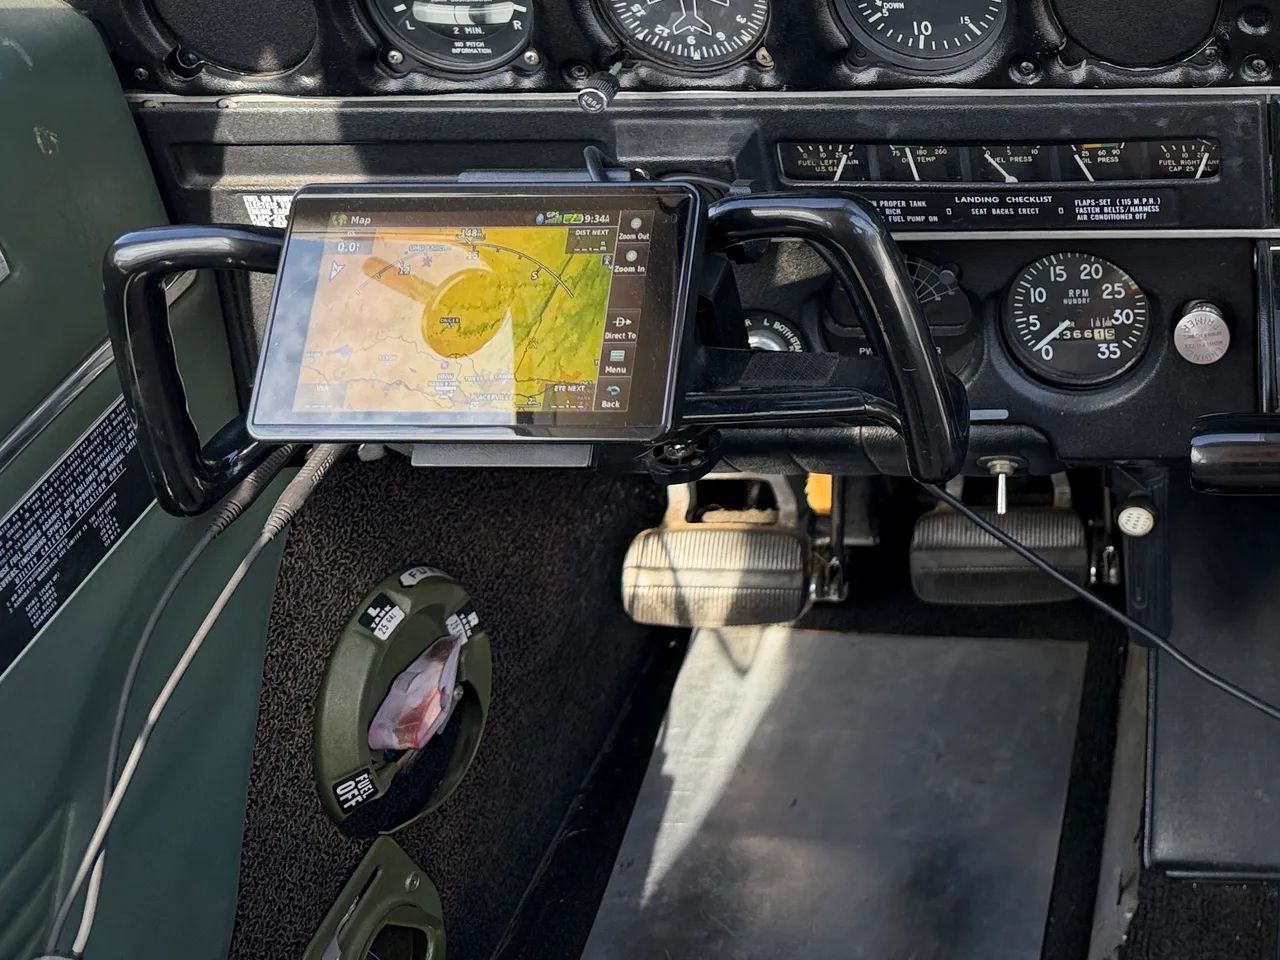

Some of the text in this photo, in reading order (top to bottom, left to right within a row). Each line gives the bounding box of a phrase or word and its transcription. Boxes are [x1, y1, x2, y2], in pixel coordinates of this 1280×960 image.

[465, 27, 486, 35] MIN.
[880, 200, 927, 208] PROPER TANK
[955, 196, 1000, 204] LANDING
[1074, 198, 1111, 206] FLAPS-SET
[1076, 205, 1160, 214] FASTEN BELTS/HARNESS
[350, 216, 372, 226] Map
[1135, 212, 1148, 220] OFF
[1050, 266, 1067, 282] 15
[1080, 264, 1103, 280] 20
[1068, 289, 1089, 298] RPM
[1102, 284, 1126, 300] 25
[773, 320, 793, 338] BOTH
[604, 331, 636, 340] Direct To
[1098, 343, 1121, 360] 35
[605, 366, 626, 374] Menu
[602, 400, 620, 408] Back
[64, 437, 128, 508] SPIN IMMEDIATELY
[75, 464, 124, 518] OPERATION ONLY
[371, 604, 392, 630] TANK
[378, 622, 388, 636] 25
[355, 773, 374, 799] FUEL
[336, 781, 363, 808] OFF
